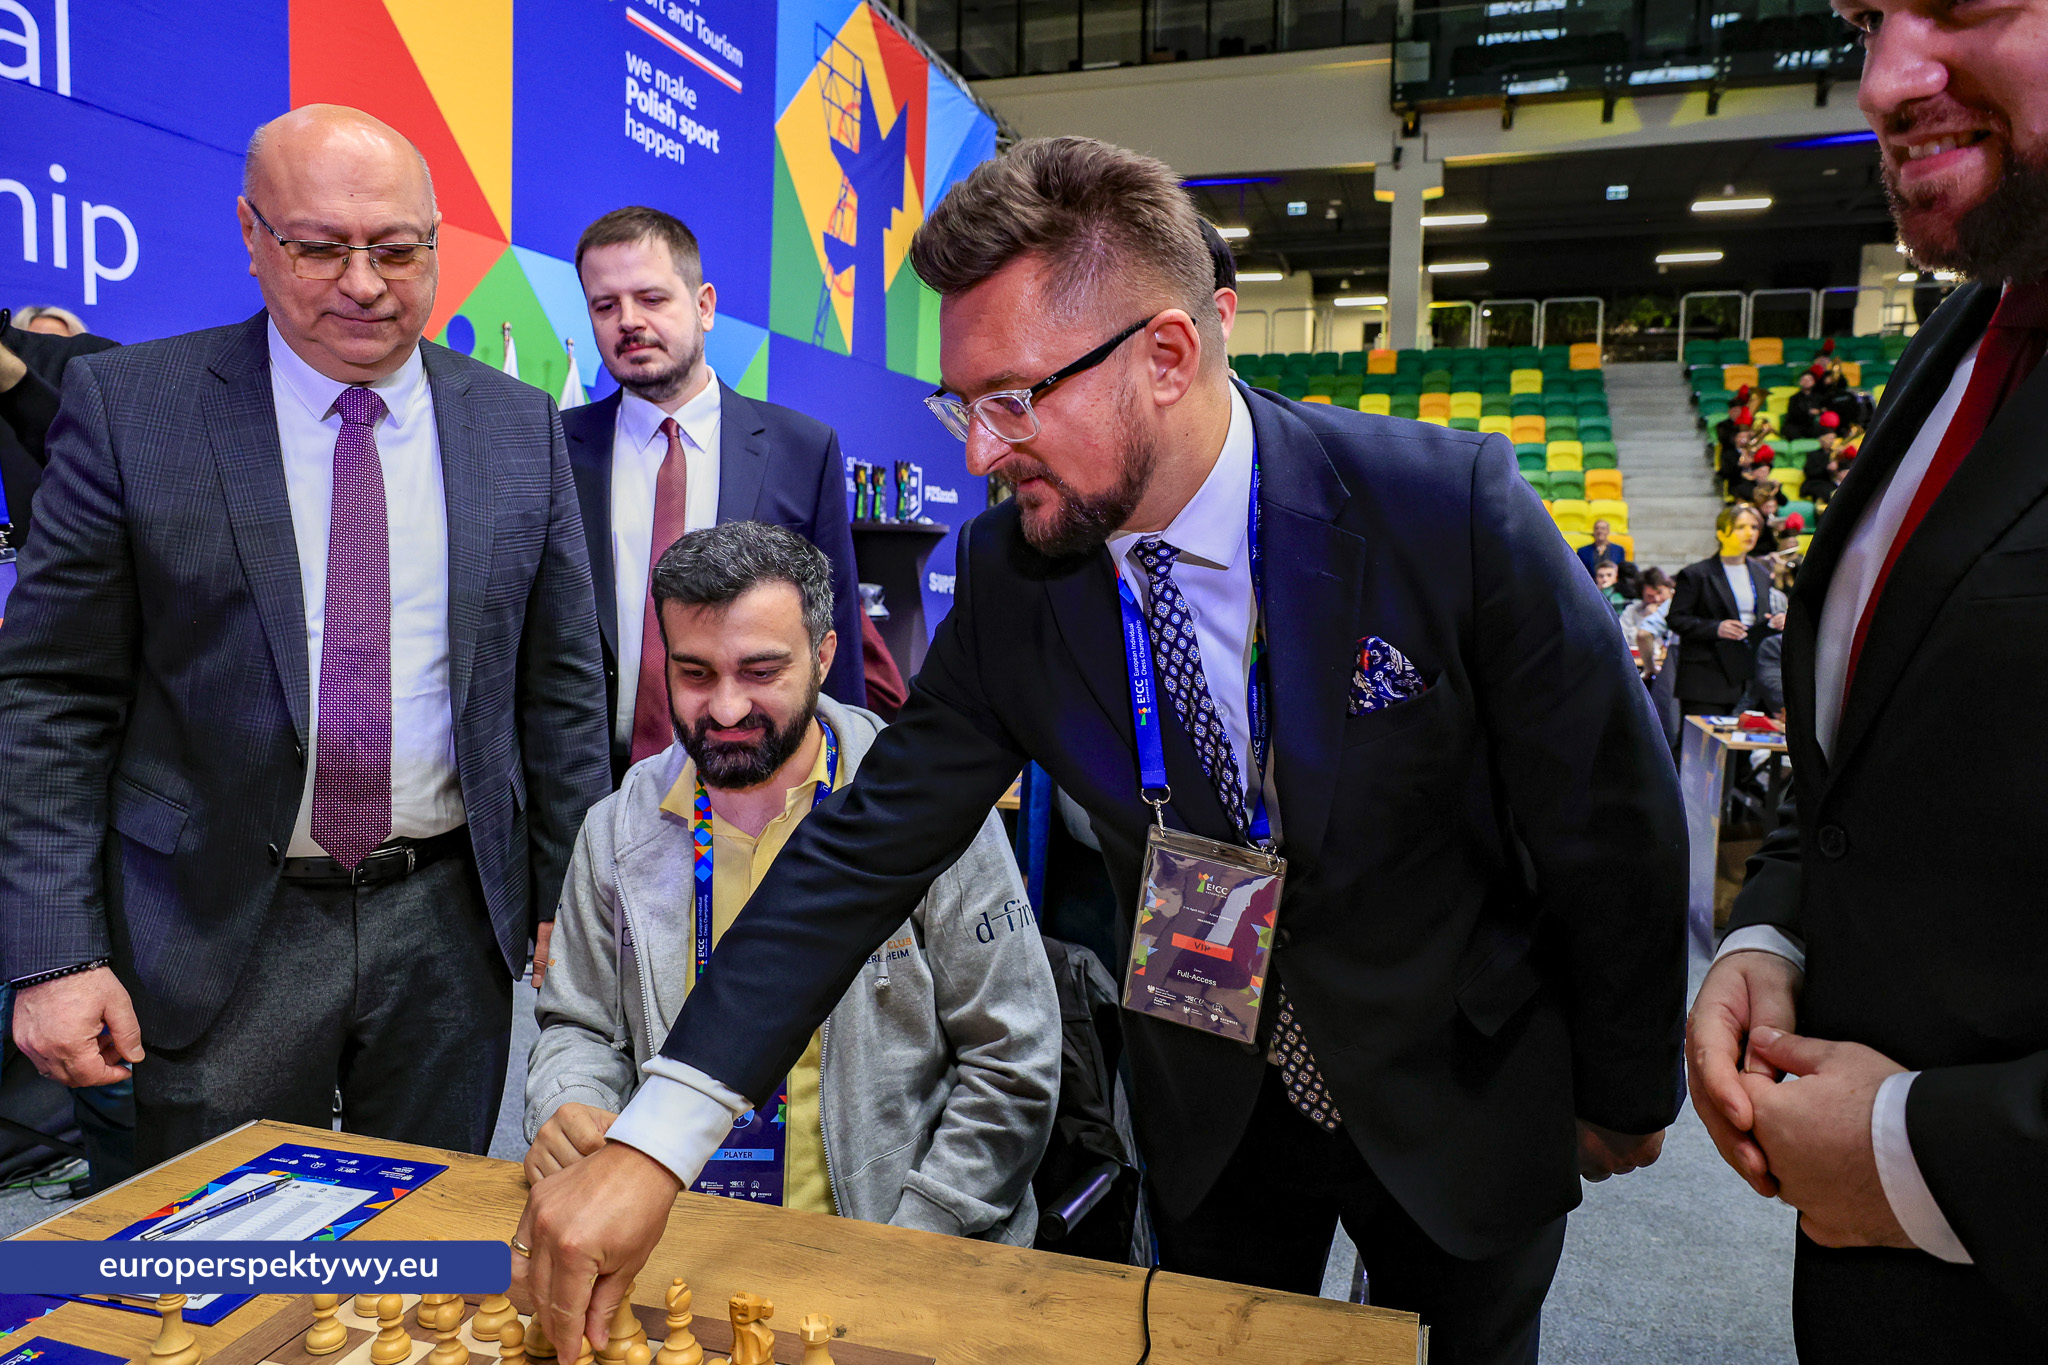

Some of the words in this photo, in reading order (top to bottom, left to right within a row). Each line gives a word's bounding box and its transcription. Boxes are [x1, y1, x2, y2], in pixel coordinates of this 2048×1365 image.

[667, 2, 693, 33] and
[695, 14, 744, 68] Tourism
[625, 50, 652, 83] we
[655, 69, 697, 110] make
[625, 76, 677, 130] Polish
[679, 114, 720, 154] sport
[625, 108, 685, 165] happen
[1128, 623, 1136, 650] Individual
[1136, 620, 1145, 658] Championship
[1194, 941, 1211, 952] VIP
[1176, 970, 1217, 987] Full-Access
